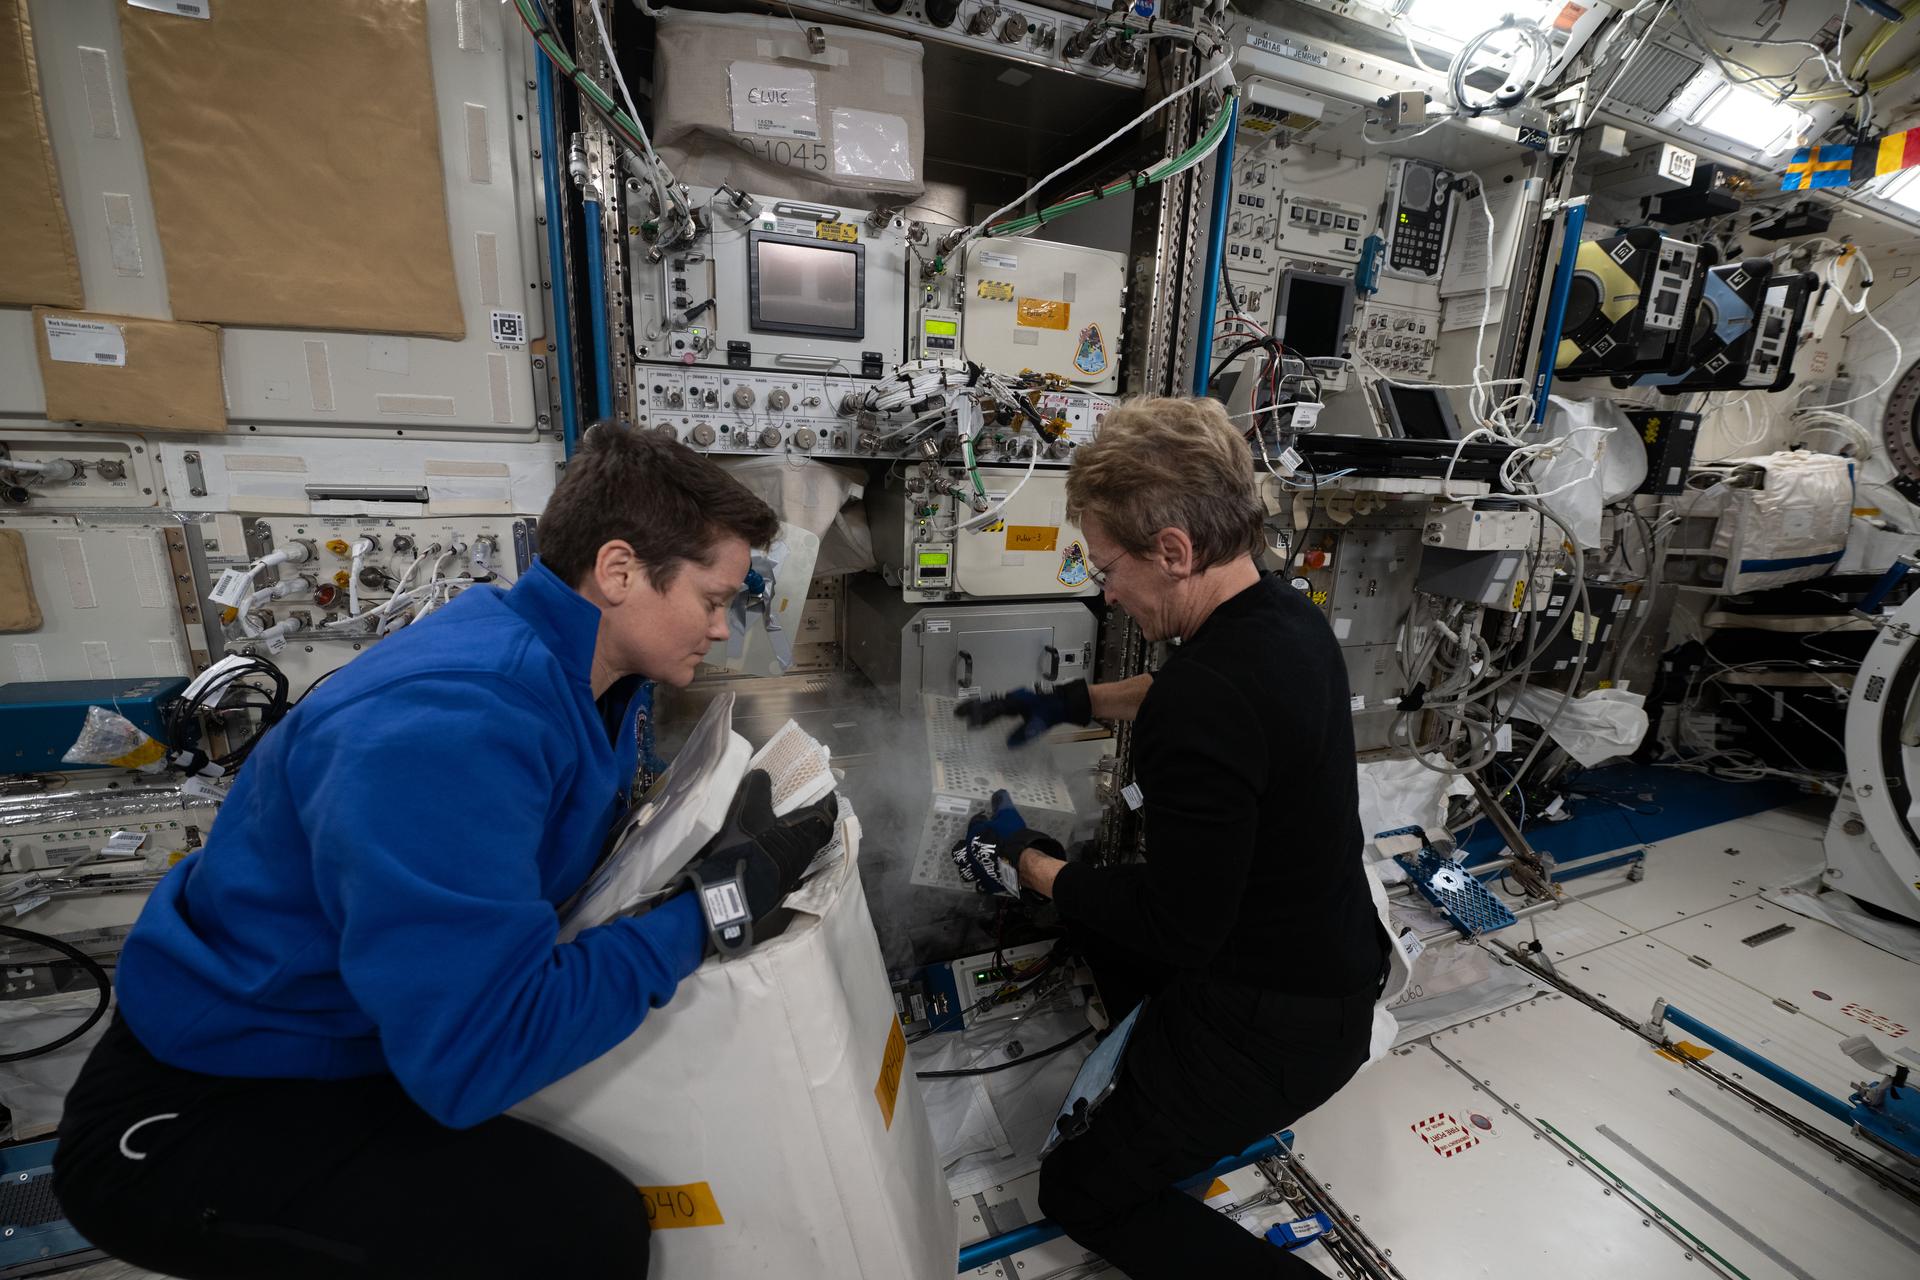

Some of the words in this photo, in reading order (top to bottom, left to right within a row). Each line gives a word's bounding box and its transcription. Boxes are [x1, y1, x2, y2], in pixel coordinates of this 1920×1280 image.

[748, 87, 788, 104] ELVIS
[1429, 1131, 1447, 1142] PORT
[1445, 1126, 1460, 1136] FIRE
